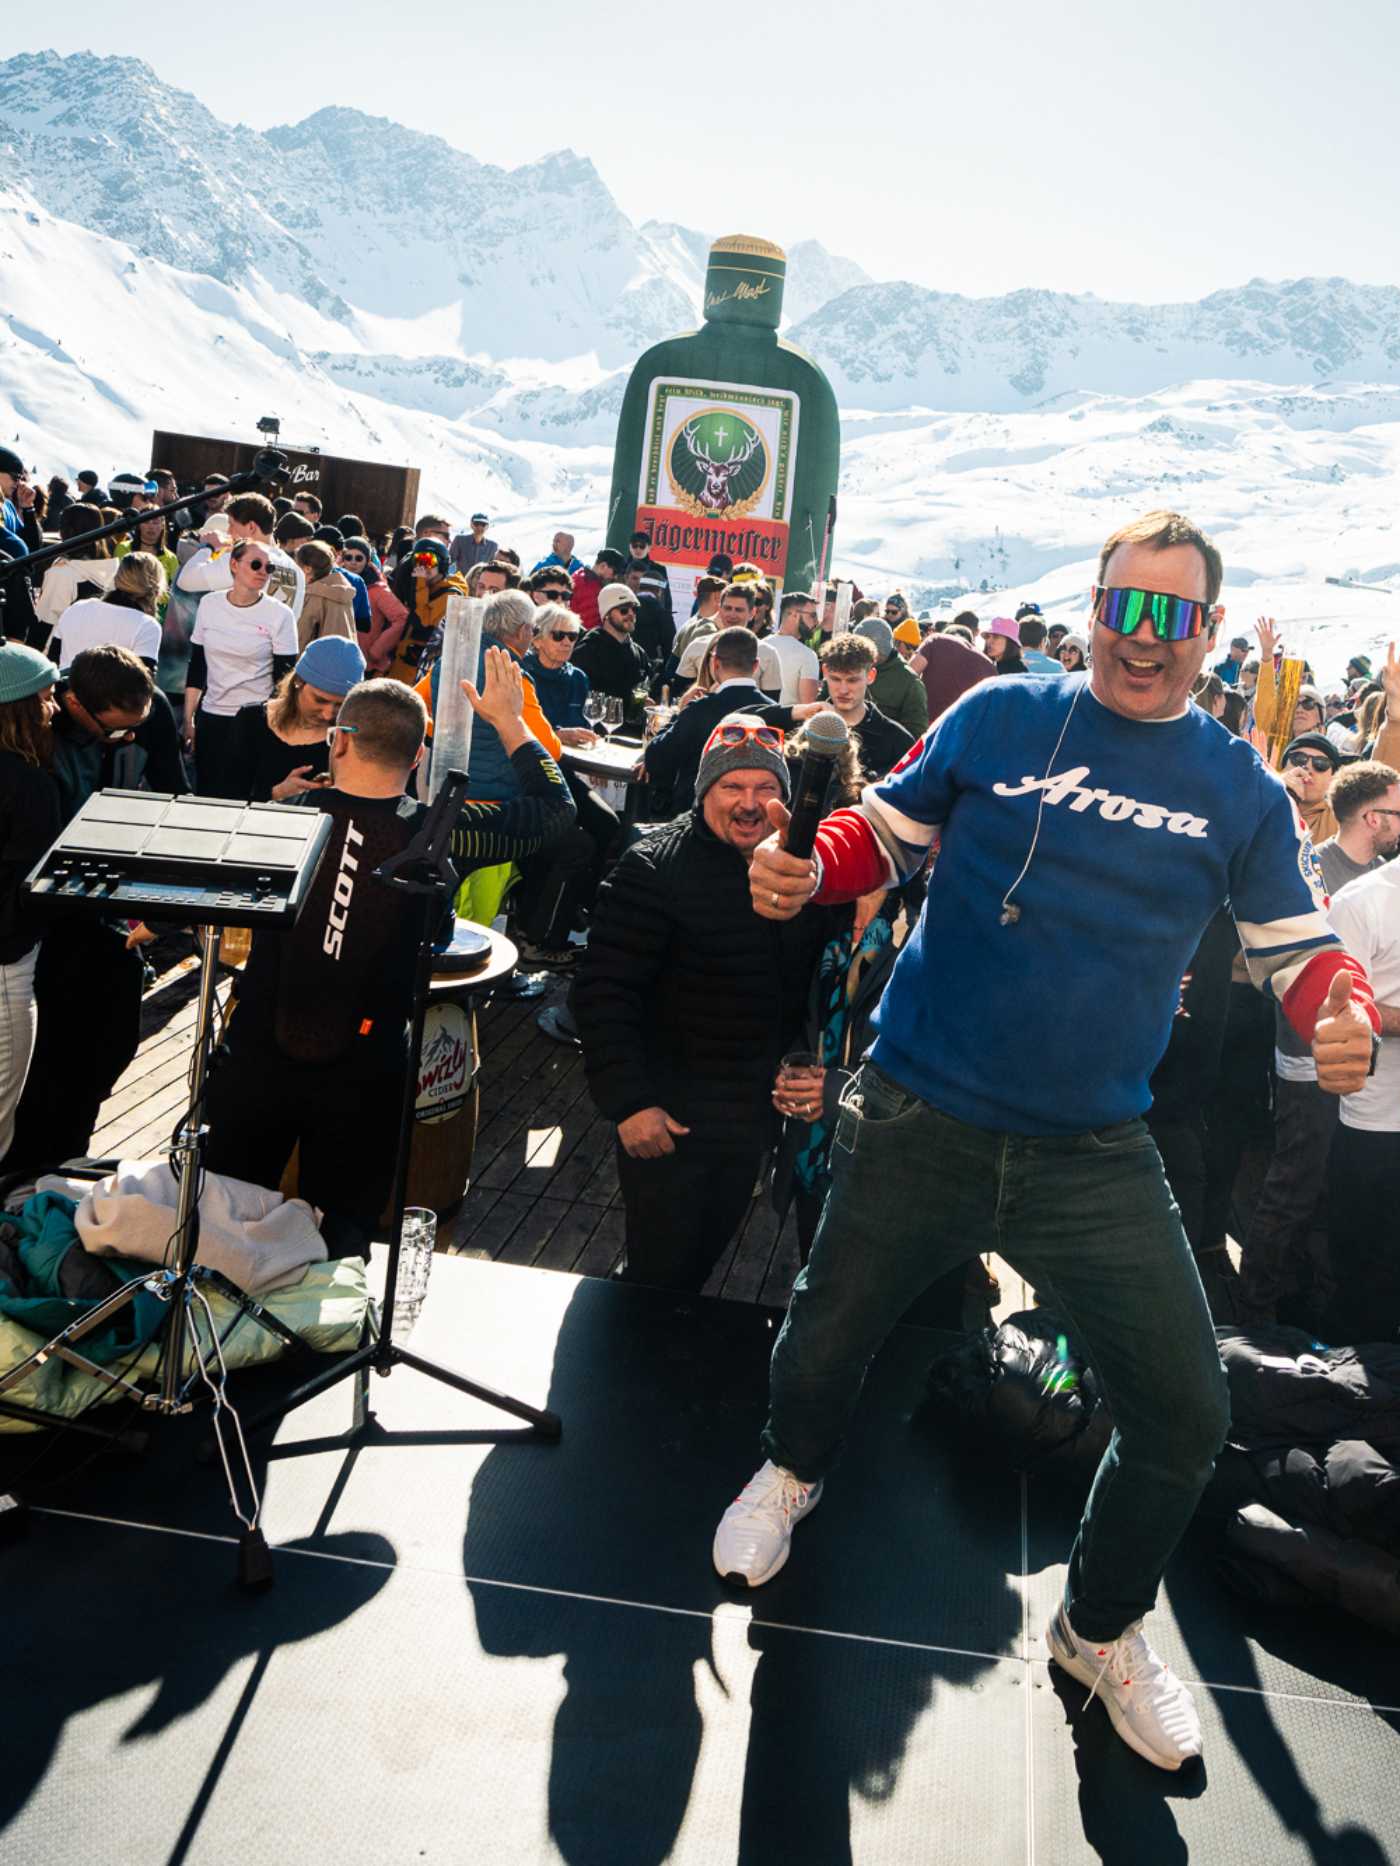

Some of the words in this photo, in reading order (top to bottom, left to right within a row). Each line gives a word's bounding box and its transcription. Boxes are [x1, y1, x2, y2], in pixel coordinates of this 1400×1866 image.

[290, 464, 320, 483] Bar
[641, 516, 782, 562] Jägermeister
[992, 766, 1209, 838] Arosa
[323, 819, 364, 960] SCOTT
